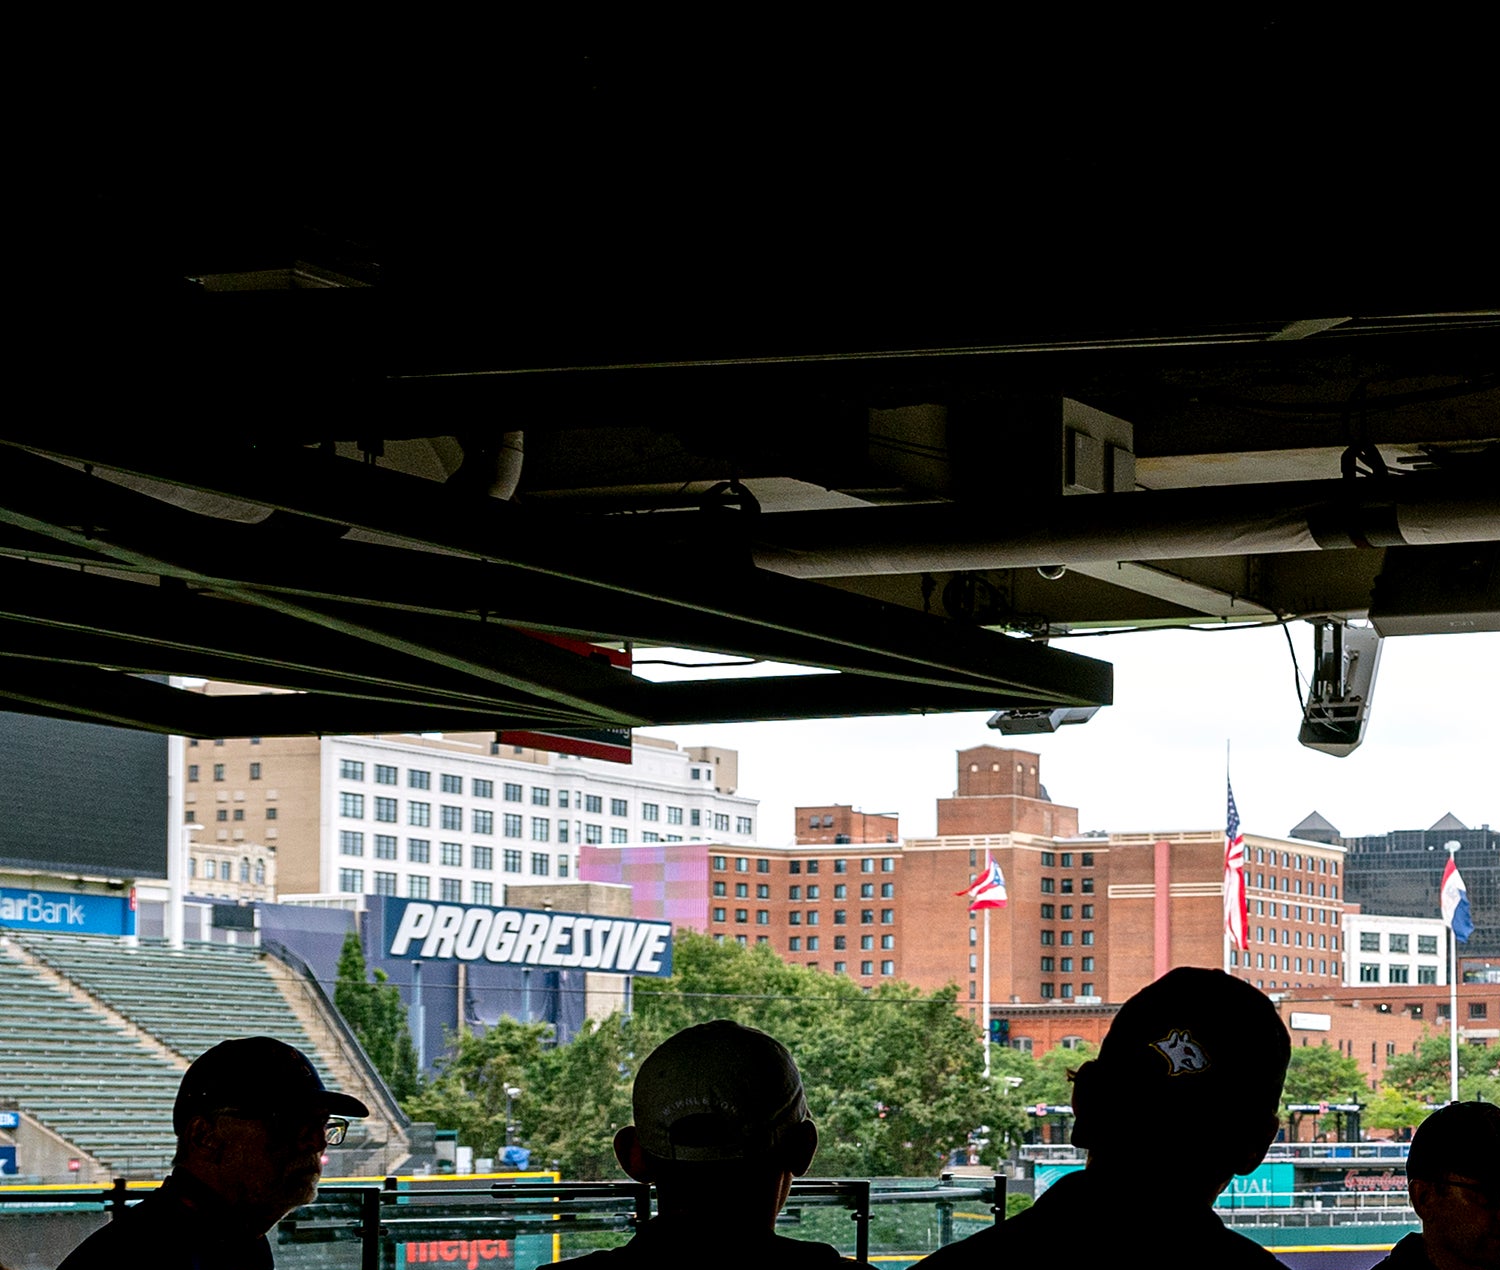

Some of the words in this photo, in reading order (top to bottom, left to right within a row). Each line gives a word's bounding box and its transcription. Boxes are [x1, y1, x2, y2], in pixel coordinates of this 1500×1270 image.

[0, 893, 85, 926] arBank
[390, 901, 671, 973] PROGRESSIVE
[1232, 1178, 1271, 1193] UAL
